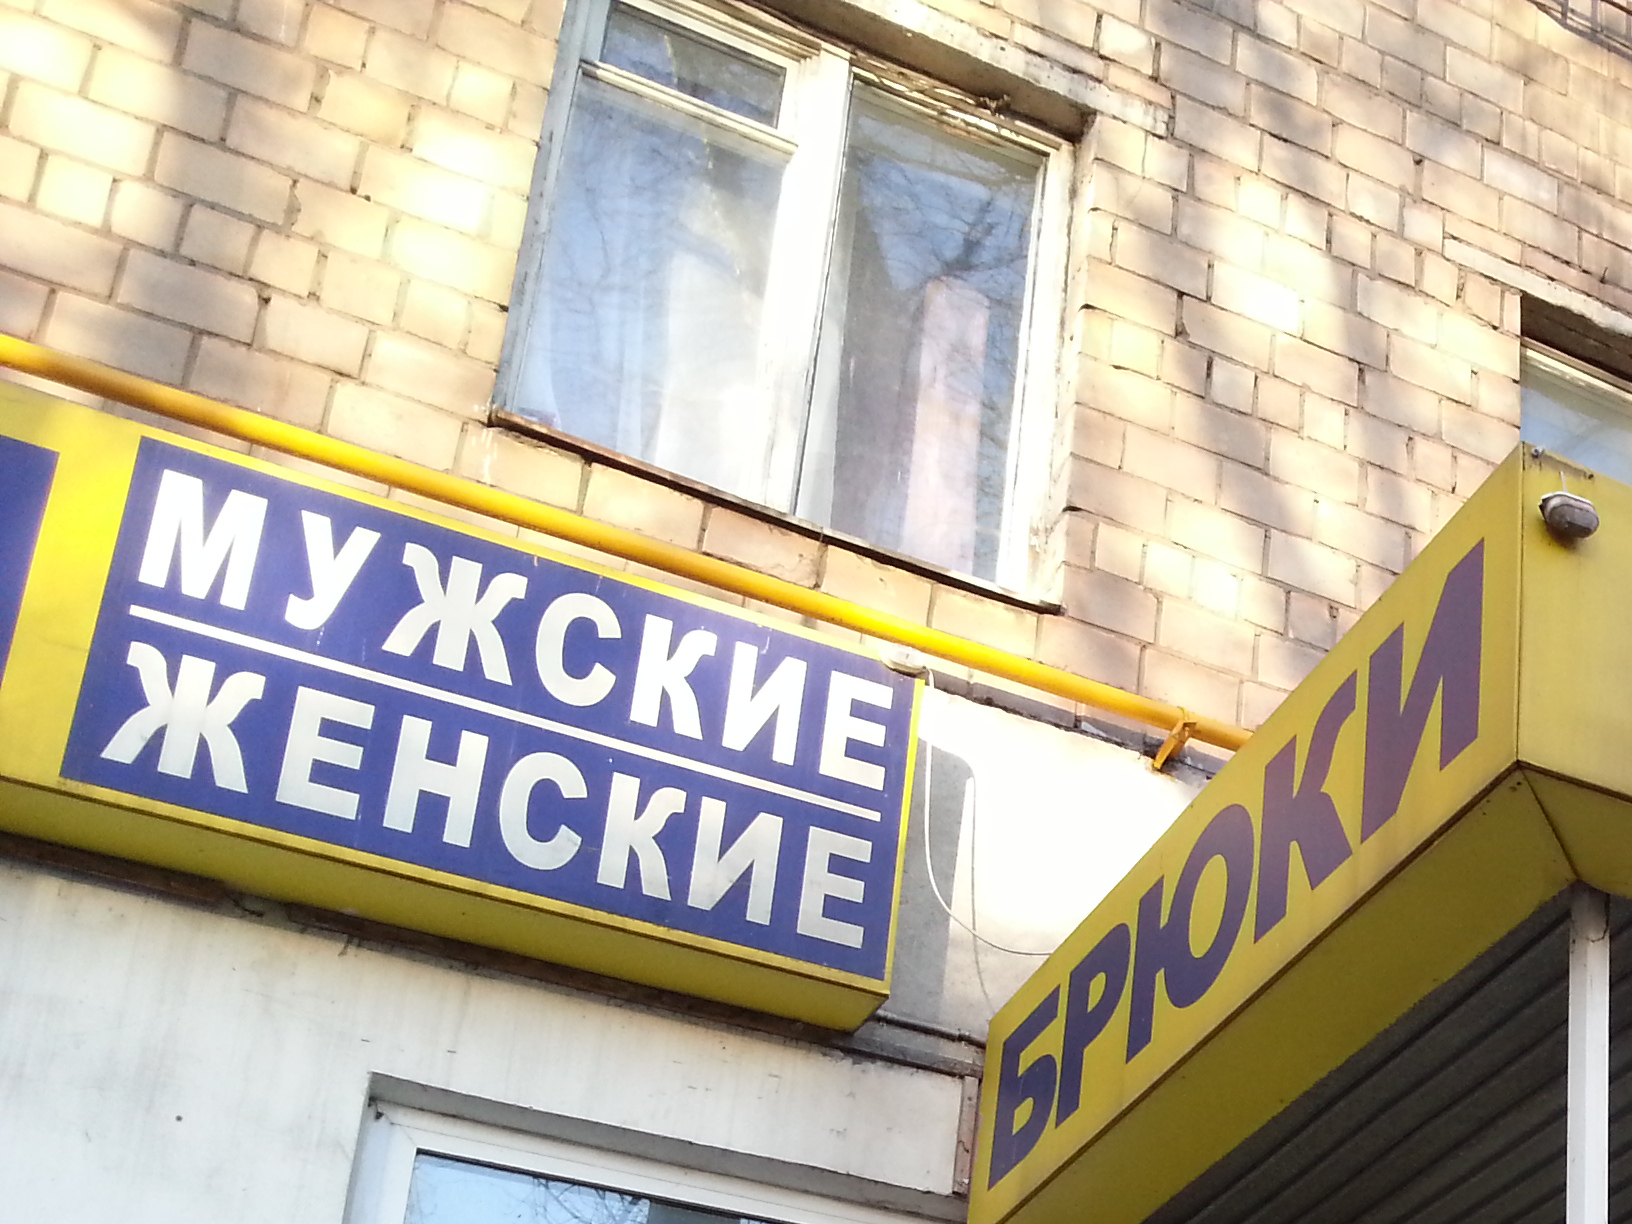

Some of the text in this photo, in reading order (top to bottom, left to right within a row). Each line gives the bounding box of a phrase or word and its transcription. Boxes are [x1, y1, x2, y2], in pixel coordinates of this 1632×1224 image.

[140, 468, 893, 790] МУЖСКИЕ
[100, 642, 873, 949] ЖЕНСКИЕ
[988, 537, 1484, 1191] БРЮКИ
